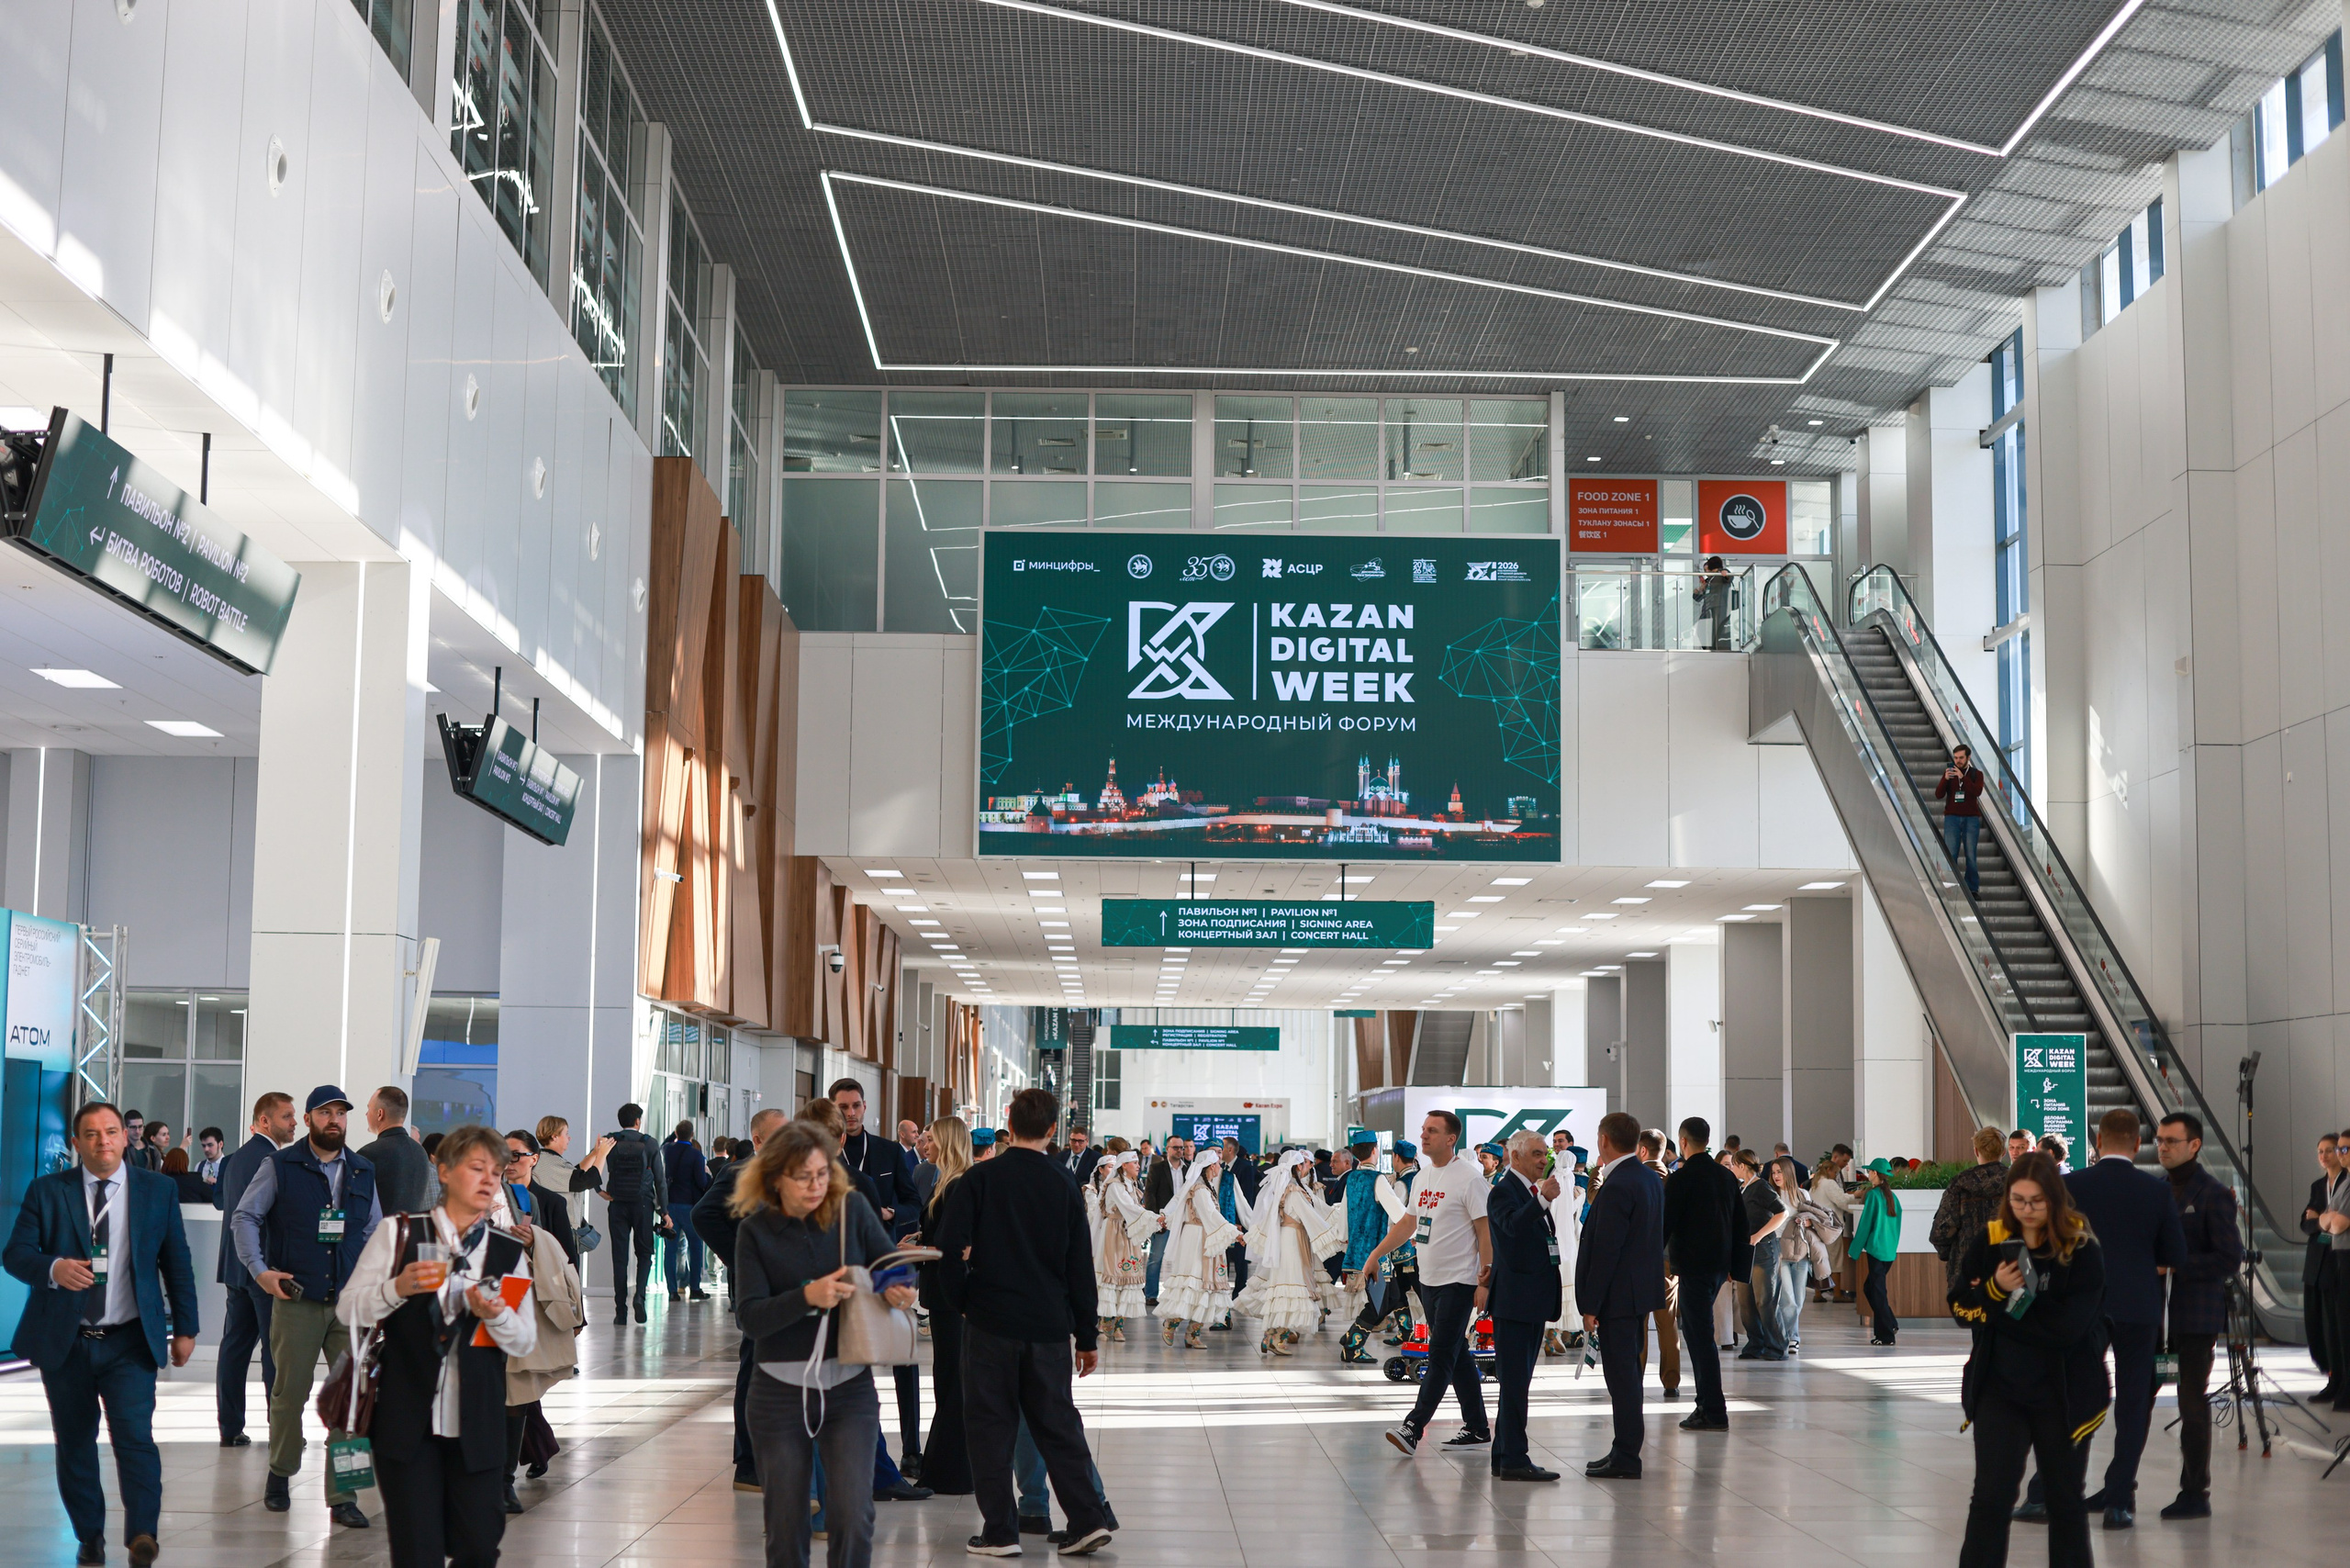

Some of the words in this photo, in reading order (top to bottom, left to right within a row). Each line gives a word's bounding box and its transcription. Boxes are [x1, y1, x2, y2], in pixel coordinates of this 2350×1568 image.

[1577, 491, 1608, 501] FOOD
[1611, 492, 1641, 501] ZONE
[1644, 493, 1650, 502] 1
[119, 483, 175, 534] ПАВИЛЬОН
[173, 518, 191, 545] №2
[106, 531, 140, 568] БИТВА
[139, 552, 184, 593] РОБОТОВ
[196, 534, 236, 575] PAVILION
[233, 557, 250, 584] №2
[1287, 564, 1324, 575] АСЦР
[189, 583, 220, 615] ROBOT
[217, 601, 248, 633] BATTLE
[1270, 602, 1414, 629] KAZAN
[1270, 636, 1414, 663] DIGITAL
[1270, 671, 1416, 702] WEEK
[1126, 713, 1331, 733] МЕЖДУНАРОДНЫЙ
[1338, 716, 1416, 732] ФОРУМ
[1179, 907, 1239, 916] ПАВИЛЬОН
[1241, 908, 1258, 916] №1
[1270, 908, 1319, 917] PAVILION
[1321, 908, 1337, 917] №1
[1178, 919, 1208, 927] ЗОНА
[1210, 919, 1286, 929] ПОДПИСАНИЯ
[1299, 920, 1343, 928] SIGNING
[1345, 920, 1373, 929] AREA
[1178, 929, 1253, 940] КОНЦЕРТНЫЙ
[1255, 931, 1277, 939] ЗАЛ
[1291, 931, 1339, 940] CONCERT
[1342, 932, 1369, 940] HALL
